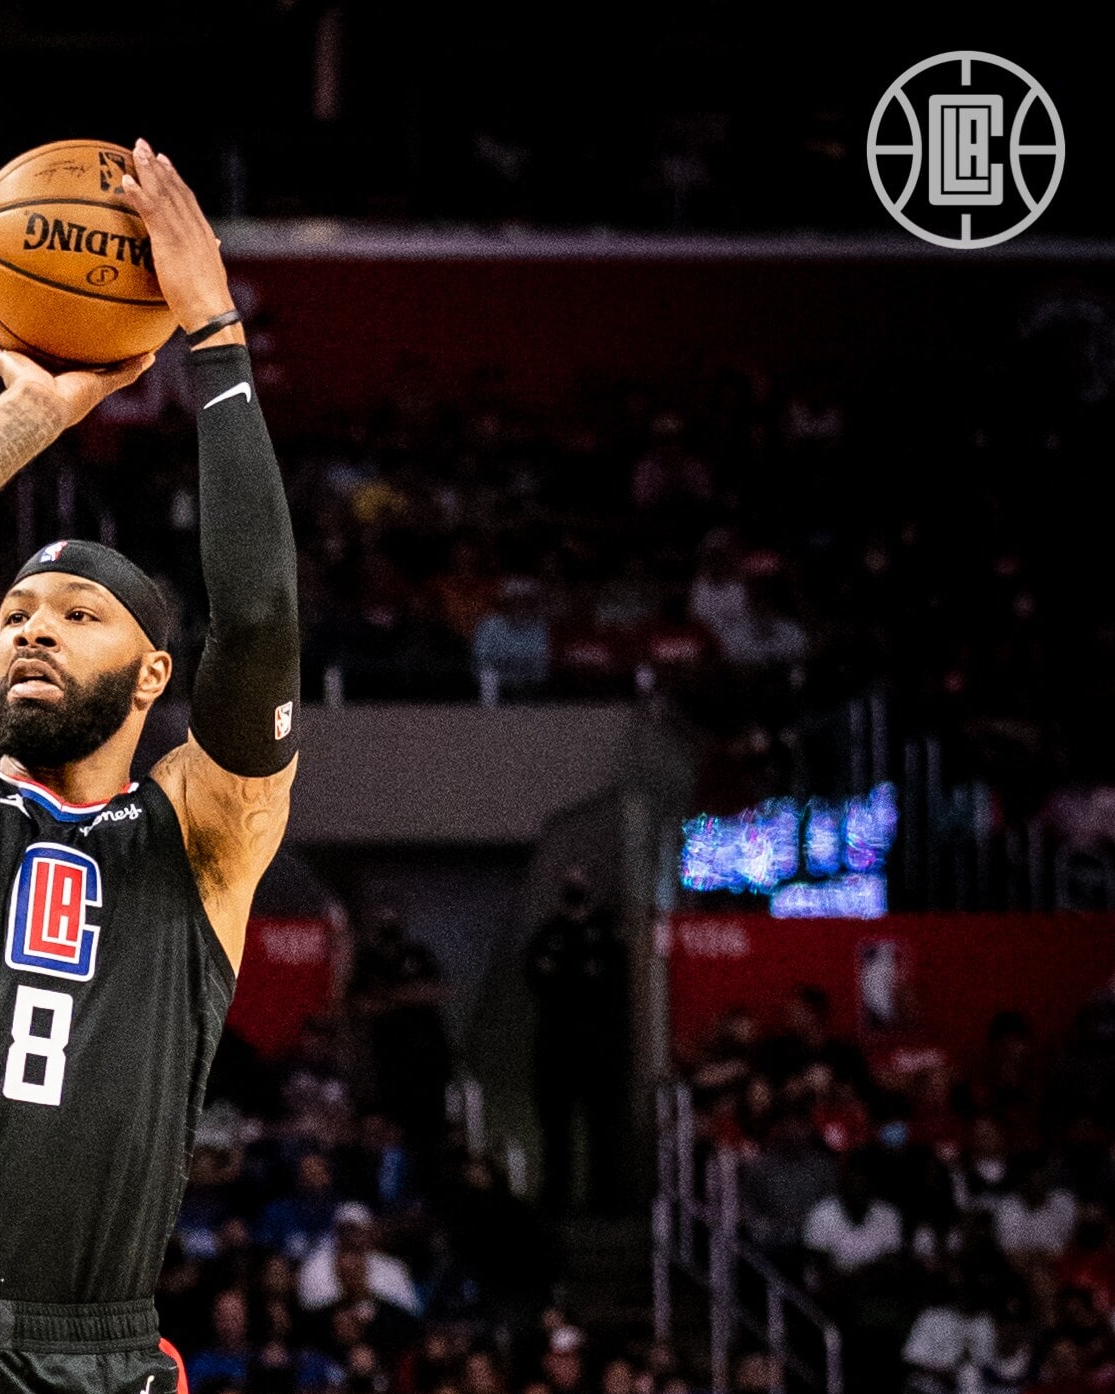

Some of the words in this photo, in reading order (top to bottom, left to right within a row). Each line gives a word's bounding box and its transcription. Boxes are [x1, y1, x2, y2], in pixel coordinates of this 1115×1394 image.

[23, 213, 155, 272] ALDING
[79, 803, 143, 837] oney
[3, 985, 74, 1106] 8
